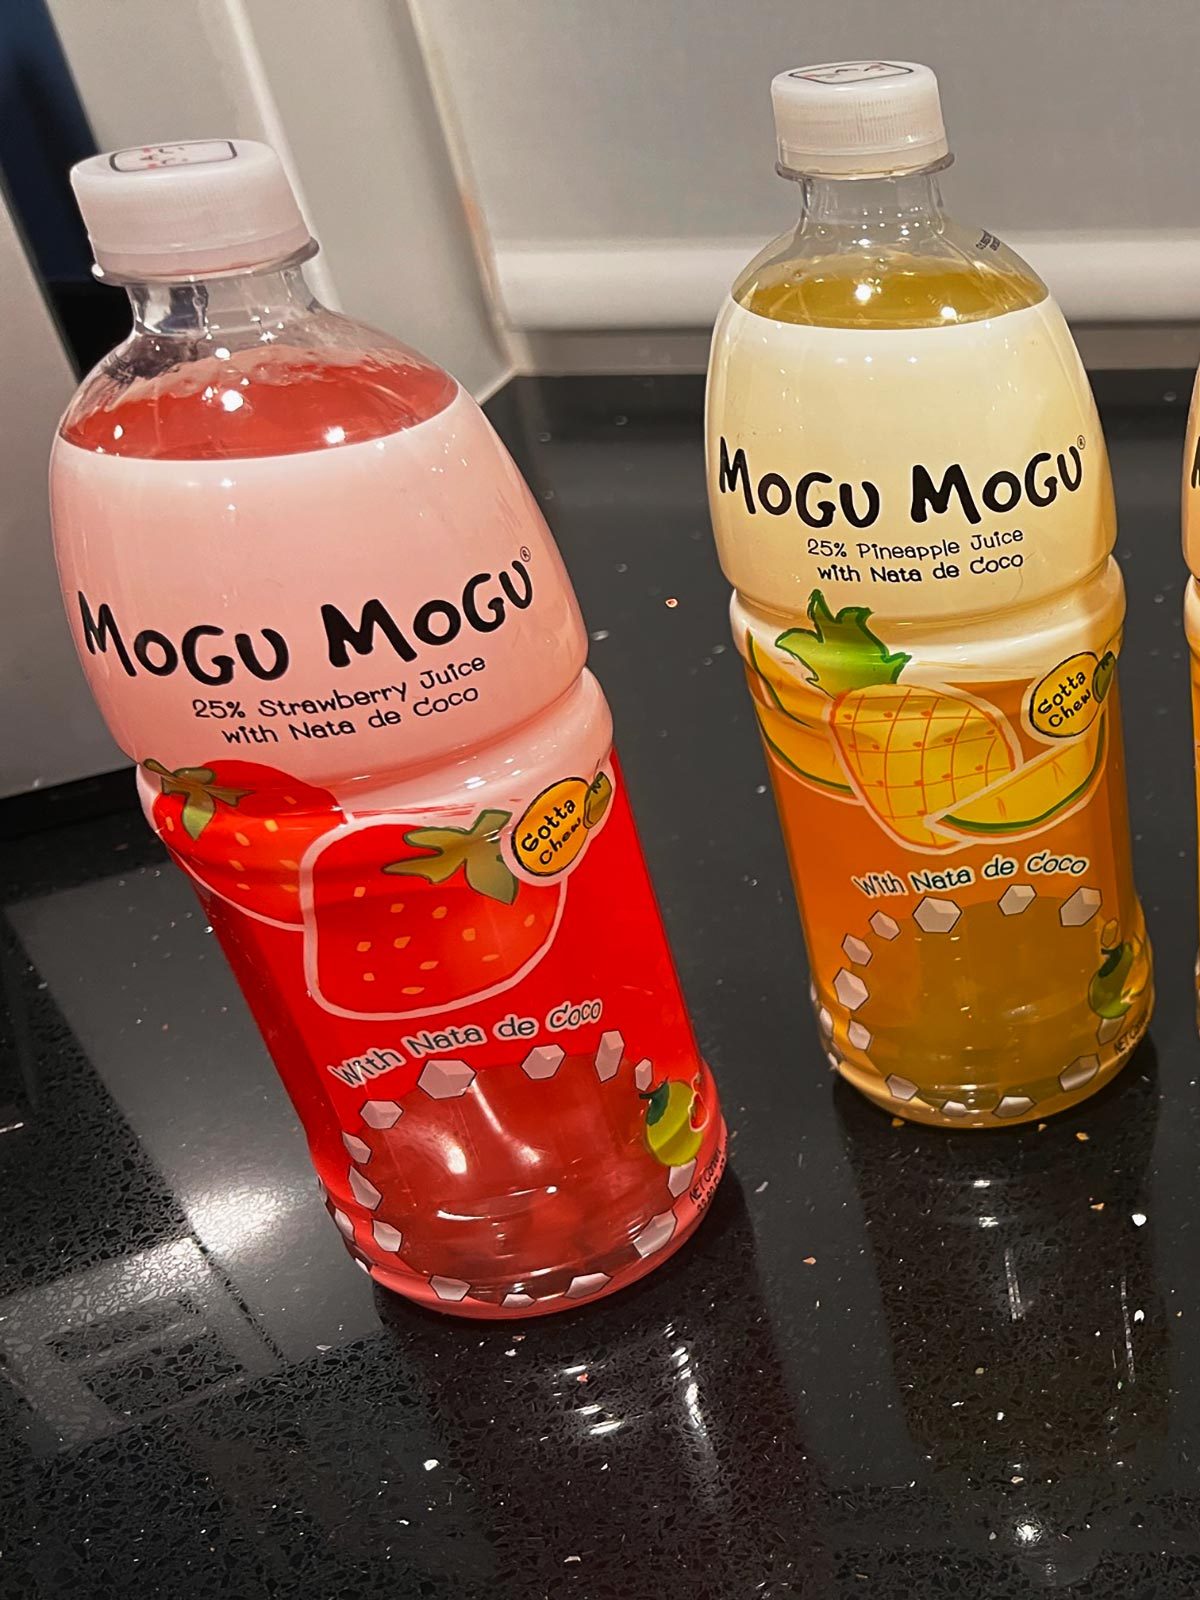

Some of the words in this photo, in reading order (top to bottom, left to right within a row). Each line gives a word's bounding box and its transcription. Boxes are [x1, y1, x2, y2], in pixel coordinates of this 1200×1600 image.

[807, 537, 848, 558] 25%
[855, 538, 961, 562] Pineapple
[970, 529, 1024, 551] Juice
[816, 563, 862, 583] with
[869, 565, 923, 583] Nata
[932, 561, 960, 579] de
[969, 553, 1024, 575] Coco
[191, 698, 247, 720] 25%
[257, 681, 407, 723] Strawberry
[419, 657, 486, 693] Juice
[1037, 671, 1087, 715] Gotta
[1048, 688, 1092, 728] Chew
[220, 724, 279, 744] with
[288, 720, 357, 741] Nata
[367, 708, 402, 729] de
[412, 683, 479, 717] Coco
[521, 799, 577, 852] Gotta
[852, 873, 907, 897] With
[909, 867, 973, 893] Nata
[983, 857, 1016, 879] de
[1026, 851, 1088, 876] Coco
[331, 1048, 402, 1088] With
[404, 1024, 485, 1056] Nata
[496, 1015, 537, 1039] de
[548, 1000, 603, 1030] Coco
